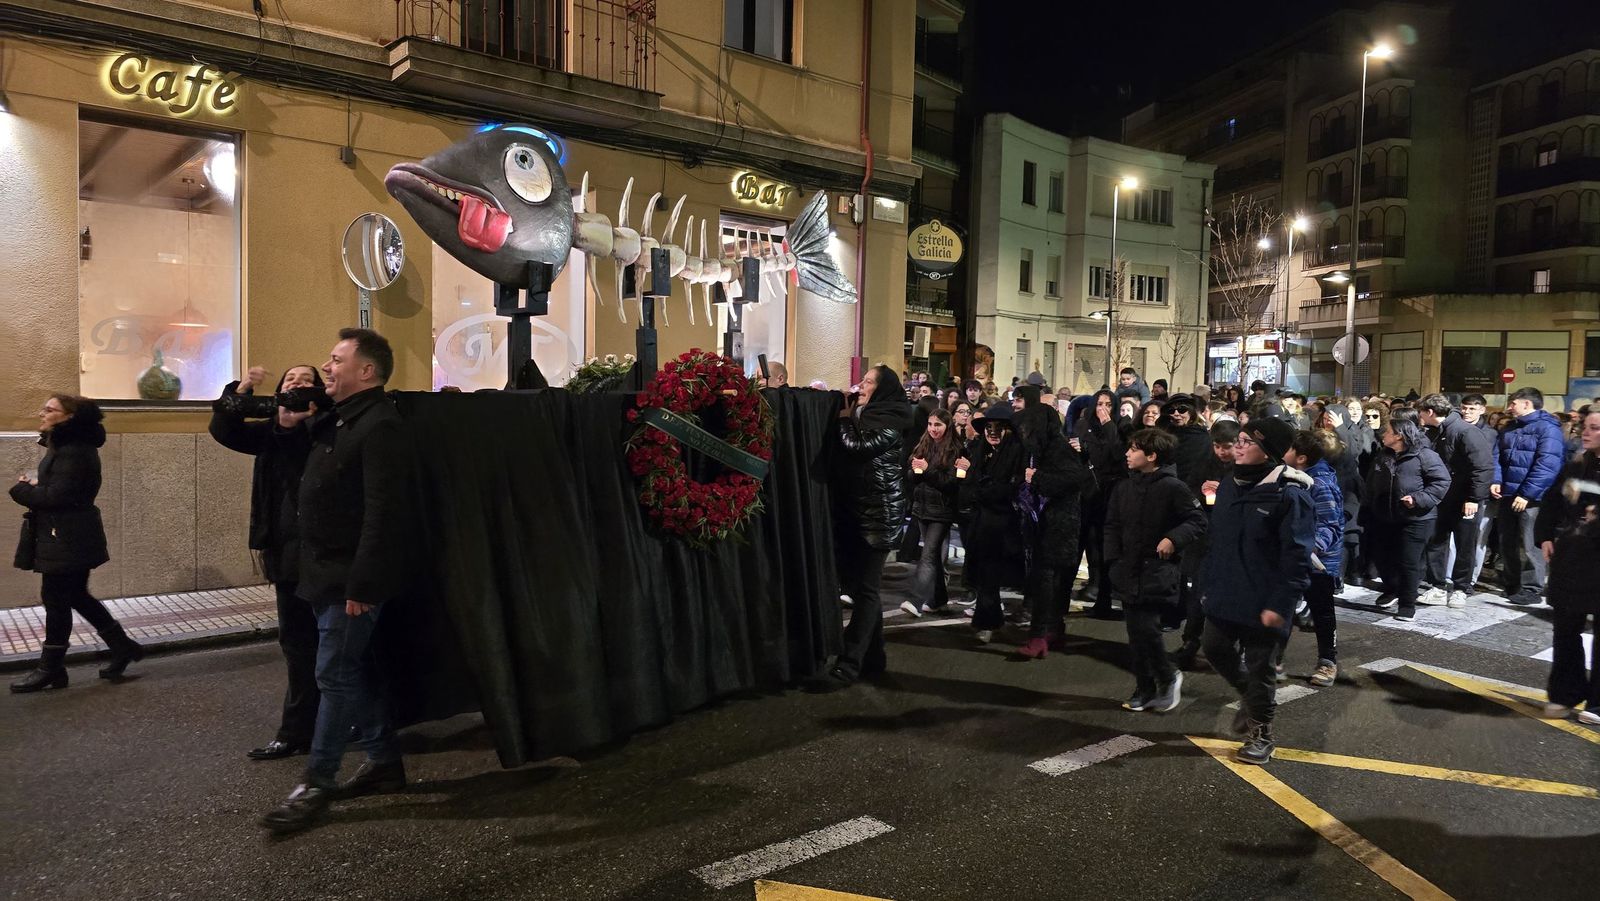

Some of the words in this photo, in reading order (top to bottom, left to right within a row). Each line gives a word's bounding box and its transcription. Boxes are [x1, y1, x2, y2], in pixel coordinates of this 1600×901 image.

[109, 53, 241, 113] Café
[736, 172, 793, 206] Bar
[917, 233, 954, 247] Estrella
[917, 245, 952, 259] Galicia
